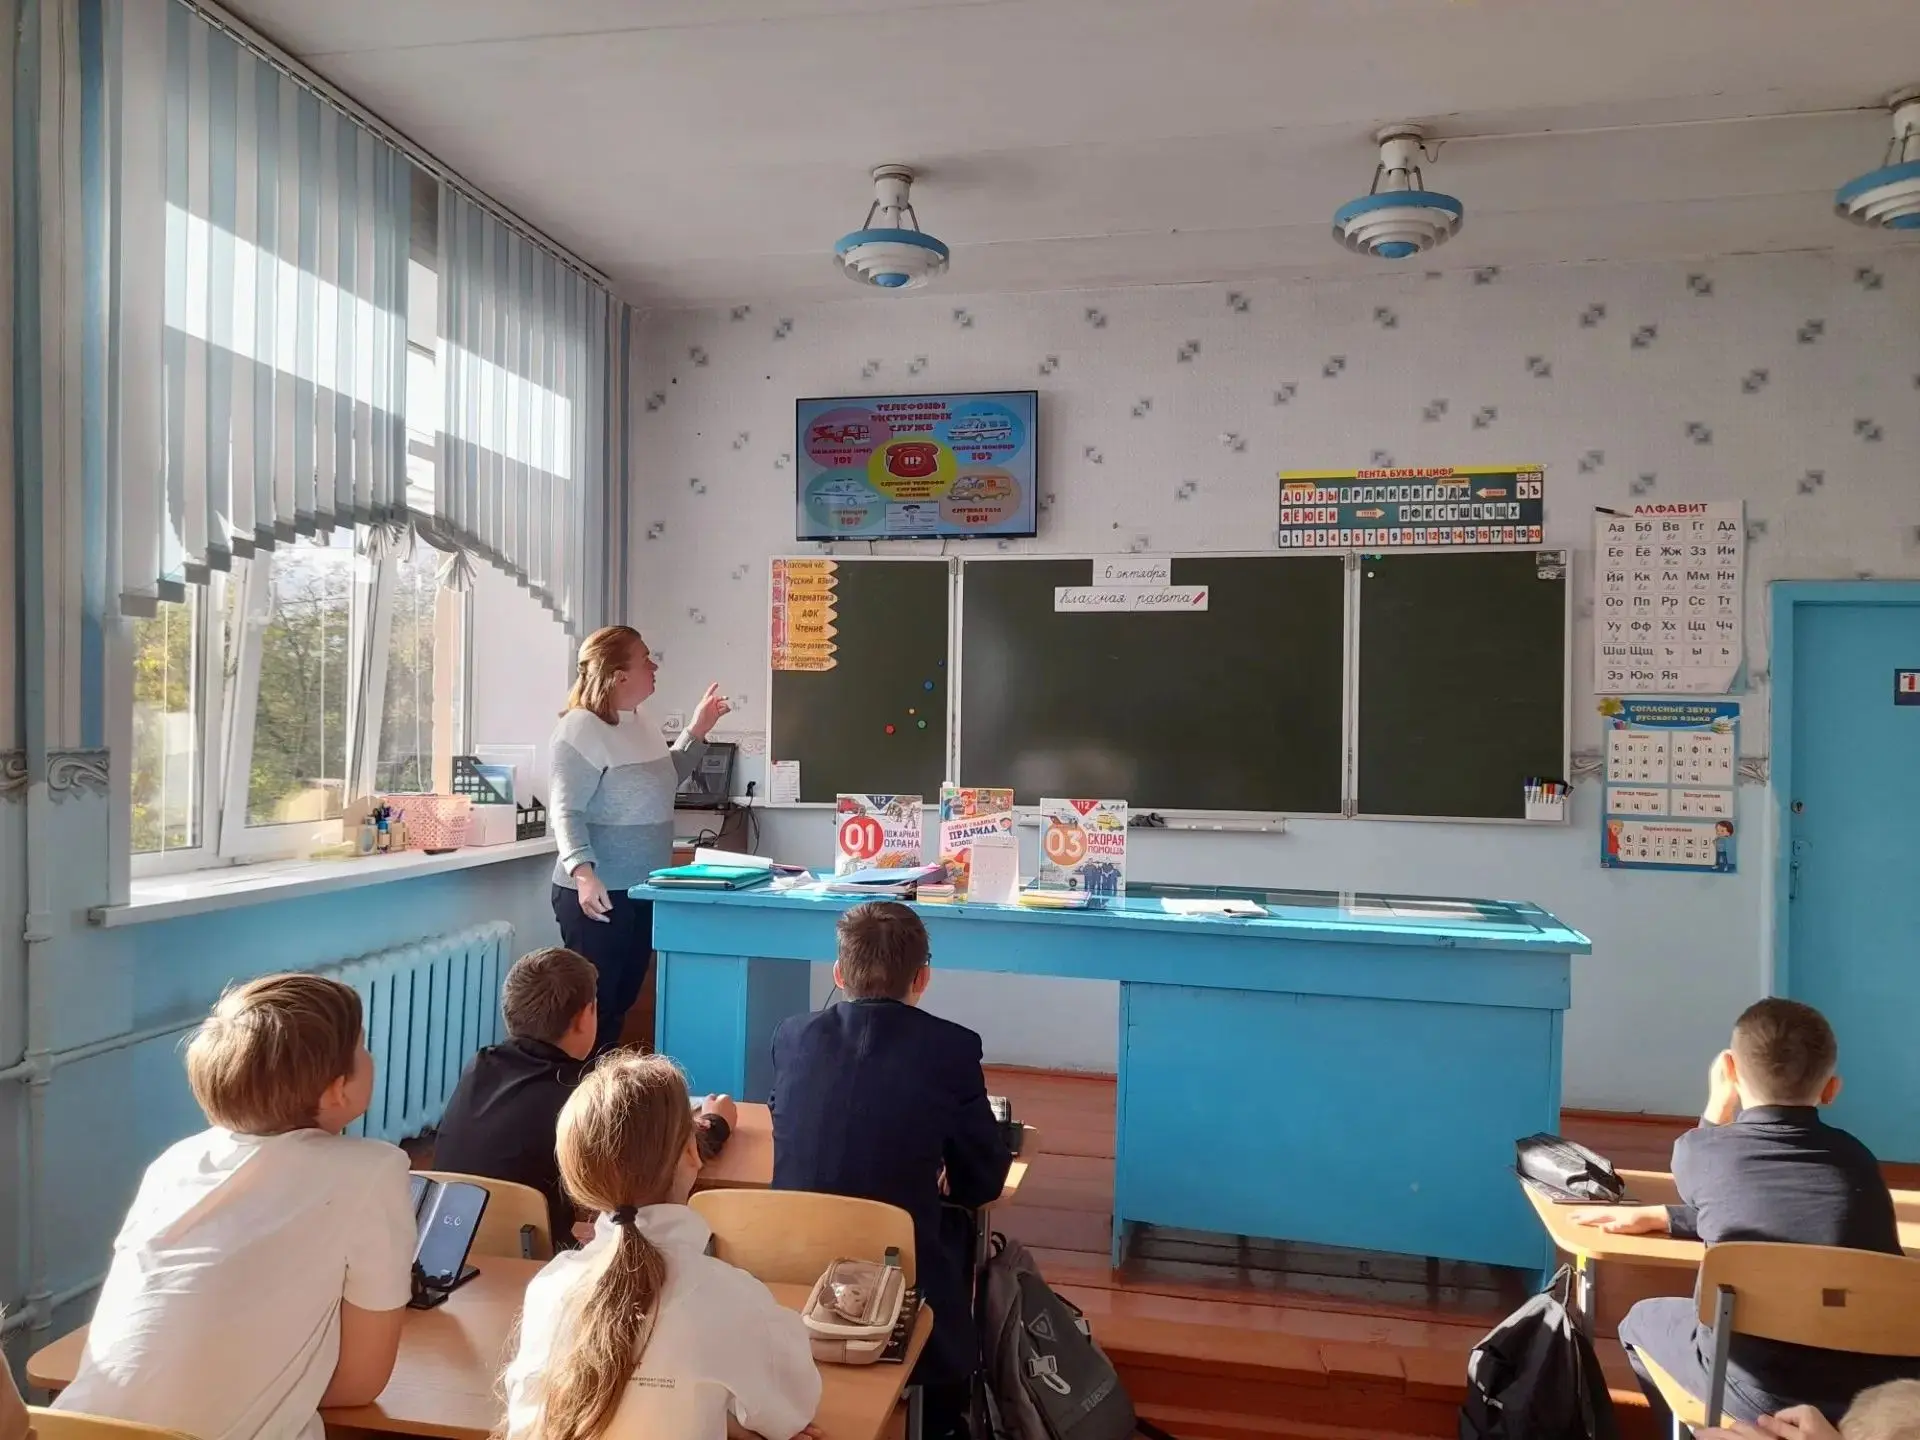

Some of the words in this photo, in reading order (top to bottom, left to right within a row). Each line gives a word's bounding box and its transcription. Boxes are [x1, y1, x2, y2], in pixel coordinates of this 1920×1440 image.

[876, 402, 946, 410] ТЕЛЕФОНЫ
[1390, 468, 1414, 476] БУКВ
[1416, 468, 1422, 476] И
[1426, 468, 1454, 477] ЦИФР
[1634, 504, 1708, 514] АЛФАВИТ
[1608, 523, 1625, 532] Аа
[1635, 522, 1652, 531] Бб
[1662, 522, 1680, 531] Вв
[1692, 522, 1704, 530] Гг
[1717, 521, 1736, 531] Дд
[1416, 532, 1424, 540] 11
[1428, 532, 1437, 540] 12
[1479, 531, 1488, 539] 16
[1492, 530, 1500, 538] 17
[1504, 530, 1513, 538] 18
[1517, 530, 1526, 538] 19
[1530, 530, 1540, 538] 20
[1608, 548, 1624, 557] Ее
[1636, 546, 1651, 557] Ёё
[1660, 547, 1681, 556] Жж
[1690, 546, 1706, 555] Зз
[1718, 546, 1735, 555] Ии
[1105, 566, 1113, 578] 6
[1116, 564, 1167, 582] октября
[1606, 571, 1624, 582] Йй
[1634, 572, 1650, 581] Кк
[1662, 572, 1678, 581] Лл
[1687, 571, 1709, 580] Мм
[1717, 571, 1735, 580] Нн
[786, 576, 813, 586] Русский
[788, 593, 834, 602] Математика
[1060, 588, 1126, 604] Классная
[1135, 588, 1192, 608] работа
[1606, 597, 1623, 606] Оо
[1634, 597, 1650, 606] Пп
[1662, 597, 1678, 607] Рр
[1688, 596, 1706, 606] Сс
[1718, 596, 1731, 605] Тт
[796, 624, 823, 632] Чтение
[1607, 622, 1621, 632] Уу
[1631, 622, 1651, 632] Фф
[1662, 621, 1676, 630] Хх
[1688, 621, 1705, 631] Цц
[1716, 621, 1733, 630] Чч
[1603, 647, 1625, 655] Шш
[1630, 647, 1653, 656] Щщ
[1607, 671, 1624, 680] Ээ
[1630, 671, 1654, 680] Юю
[1662, 671, 1678, 680] Яя
[1077, 802, 1089, 810] 112
[884, 830, 920, 838] ПОЖАРНАЯ
[949, 824, 998, 840] ПРАВИЛА
[845, 823, 874, 852] 01
[1088, 833, 1124, 846] СКОРАЯ
[884, 840, 920, 848] ОХРАНА
[1046, 829, 1082, 858] 03
[1088, 846, 1124, 855] ПОМОЩЬ
